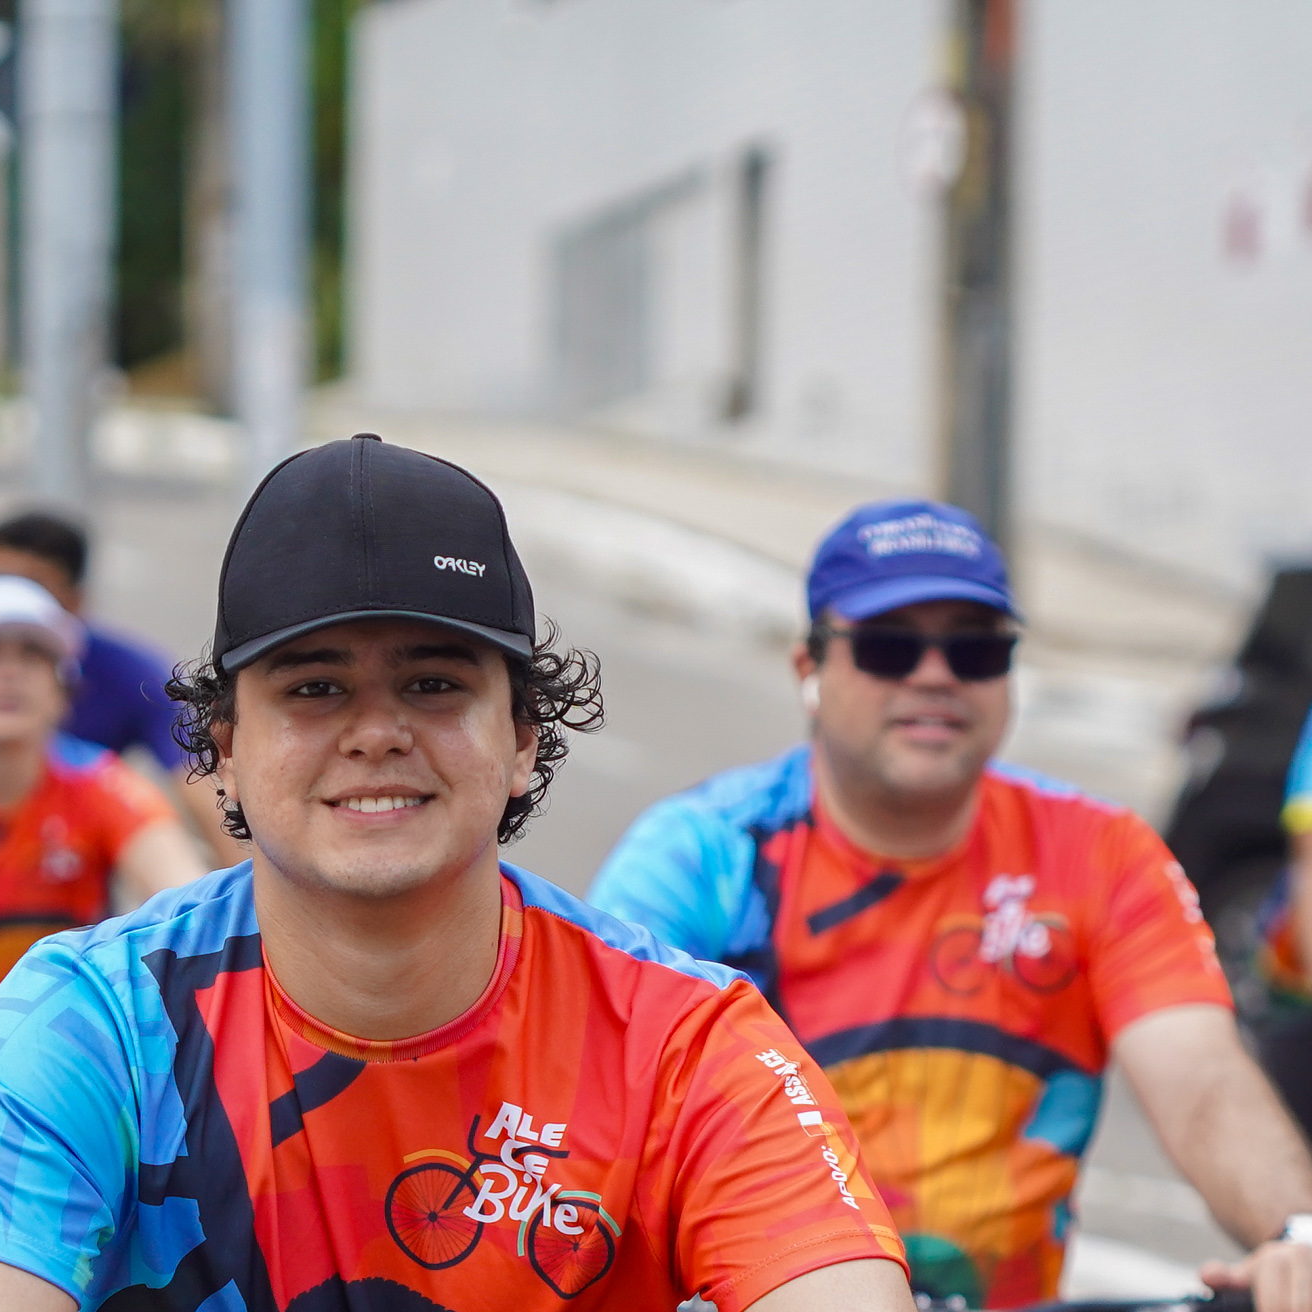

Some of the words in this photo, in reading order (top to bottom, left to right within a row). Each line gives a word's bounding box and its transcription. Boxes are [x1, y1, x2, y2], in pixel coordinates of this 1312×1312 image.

[433, 555, 486, 578] OAKLEY
[483, 1100, 568, 1148] ALE
[462, 1163, 585, 1236] Bike
